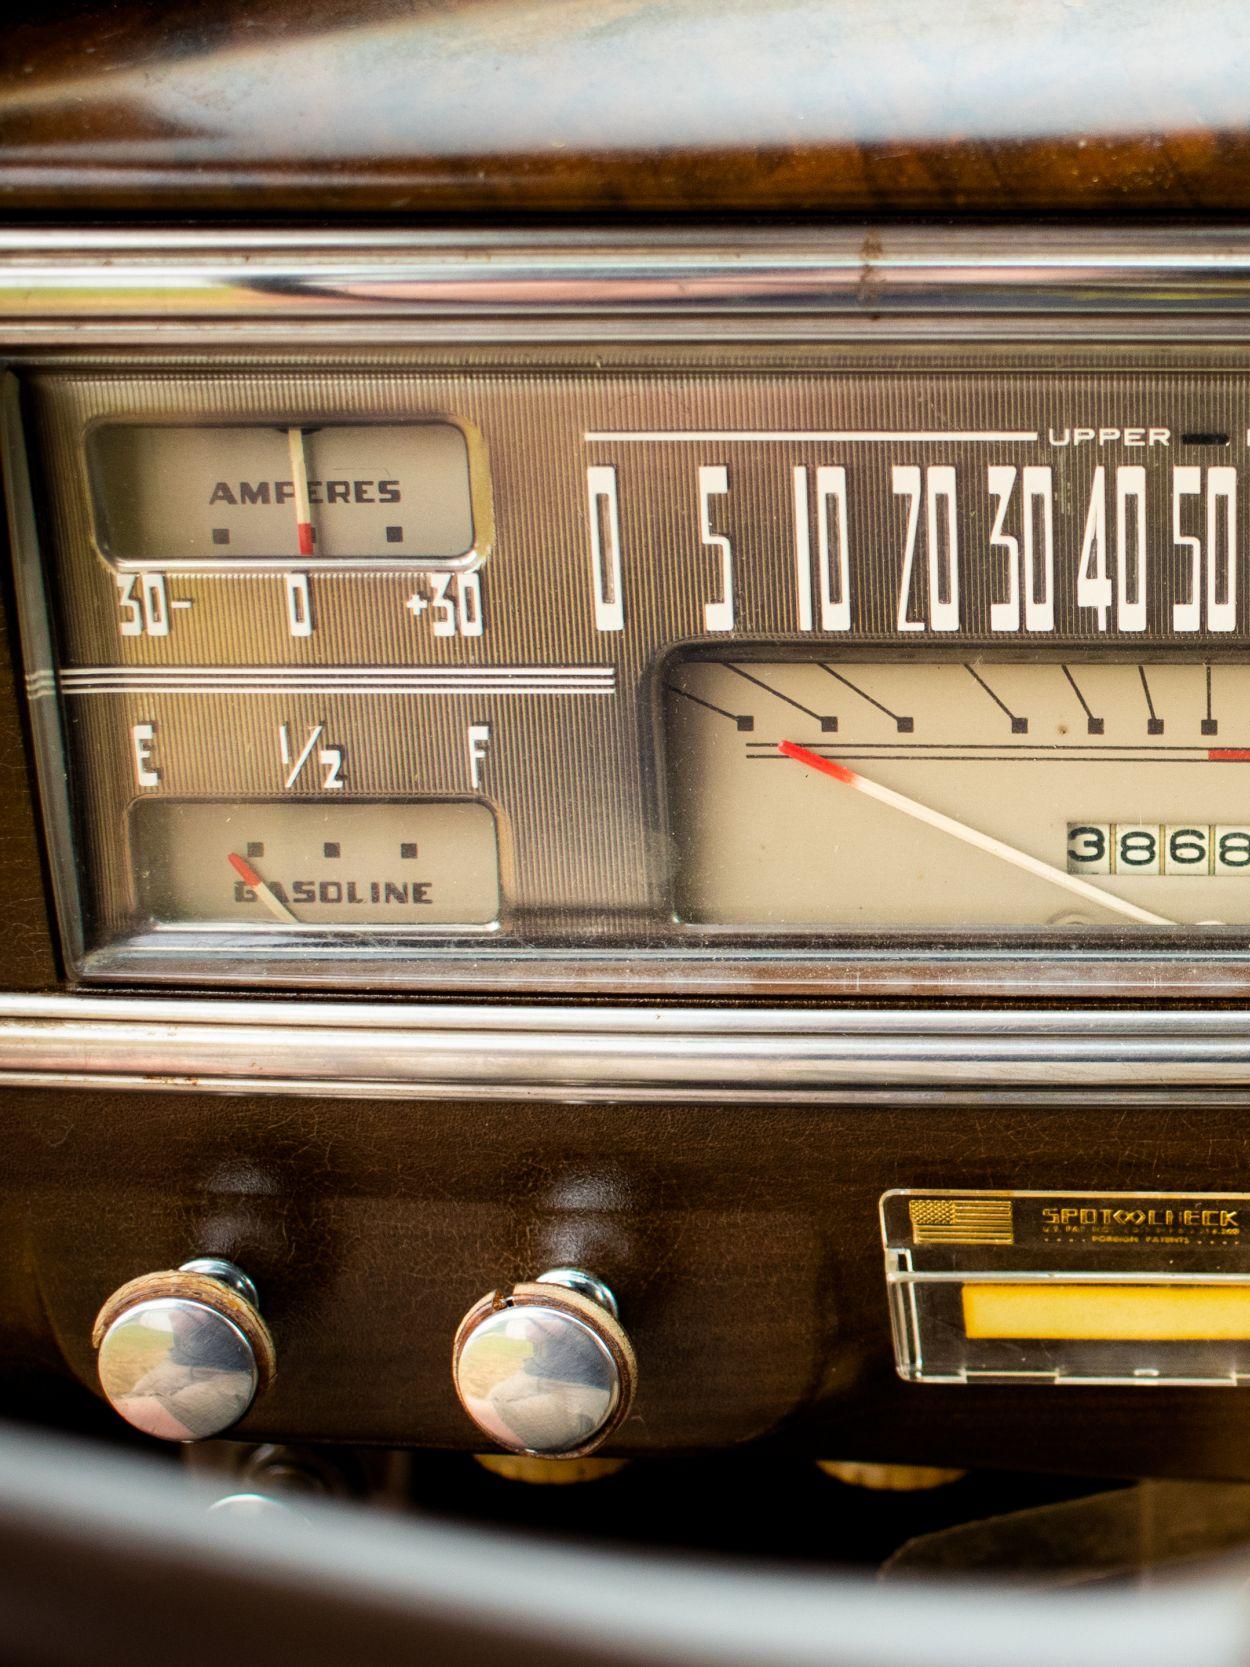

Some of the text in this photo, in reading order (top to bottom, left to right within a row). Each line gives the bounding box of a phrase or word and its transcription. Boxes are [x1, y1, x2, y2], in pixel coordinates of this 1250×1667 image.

[1048, 427, 1171, 447] UPPER
[209, 480, 401, 505] AMPERES
[587, 465, 624, 631] 0
[698, 465, 734, 632] 5
[794, 465, 851, 632] 10
[892, 465, 960, 632] 20
[987, 465, 1055, 632] 30
[1076, 465, 1147, 632] 40
[1172, 465, 1237, 632] 50
[287, 573, 312, 637] 0
[406, 573, 484, 637] +30
[133, 724, 159, 787] E
[467, 725, 490, 789] F
[234, 880, 434, 905] GASOLINE
